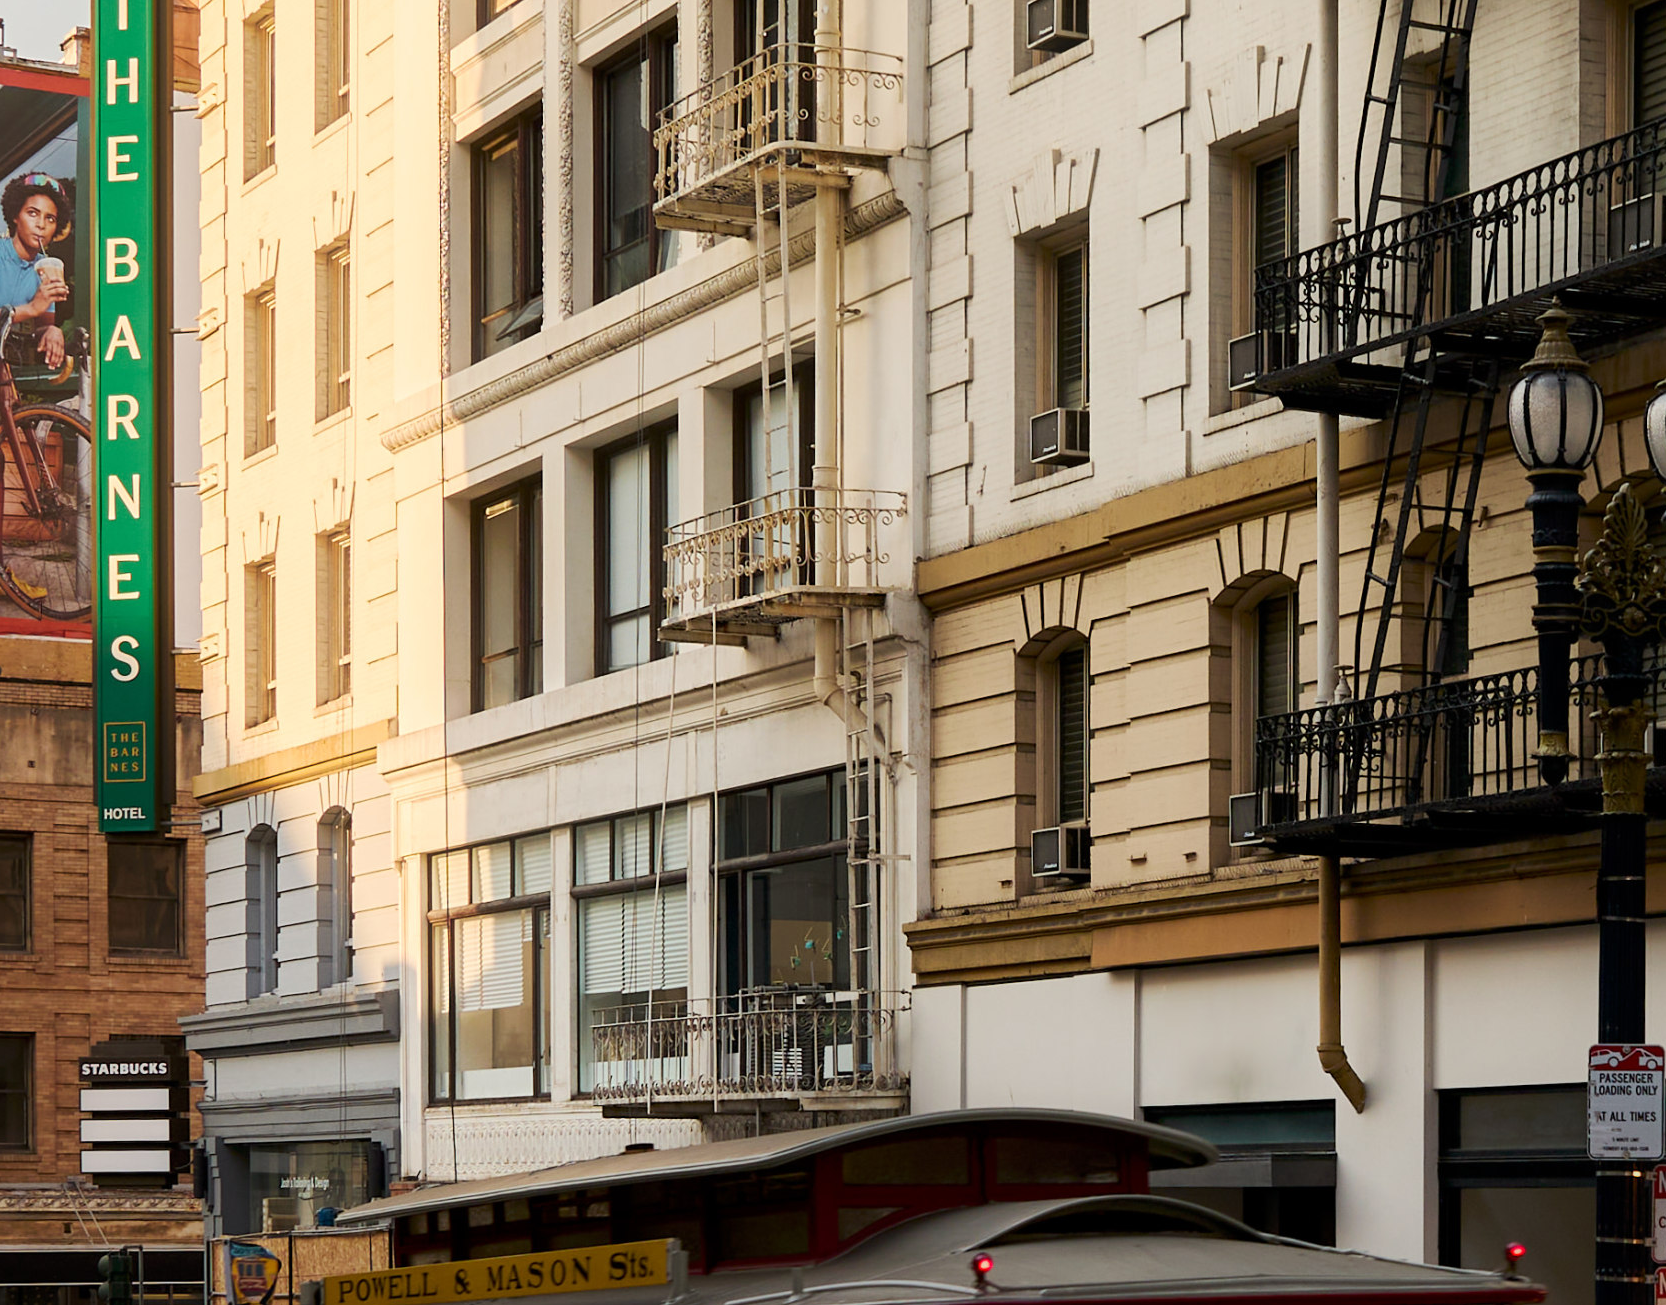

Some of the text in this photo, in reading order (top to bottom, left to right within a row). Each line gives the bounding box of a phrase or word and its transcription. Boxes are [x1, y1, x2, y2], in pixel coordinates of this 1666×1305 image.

[104, 238, 141, 683] BARNES
[111, 732, 139, 743] THE
[110, 747, 139, 757] BAR
[110, 762, 139, 772] NES
[104, 807, 146, 819] HOTEL
[81, 1062, 167, 1075] STARBUCKS
[1599, 1073, 1653, 1084] PASSENGER
[1594, 1085, 1658, 1096] LOADING ONLY
[1609, 1111, 1627, 1122] ALL
[1630, 1111, 1656, 1122] TIMES
[338, 1251, 654, 1303] POWELL & MASON Sts.
